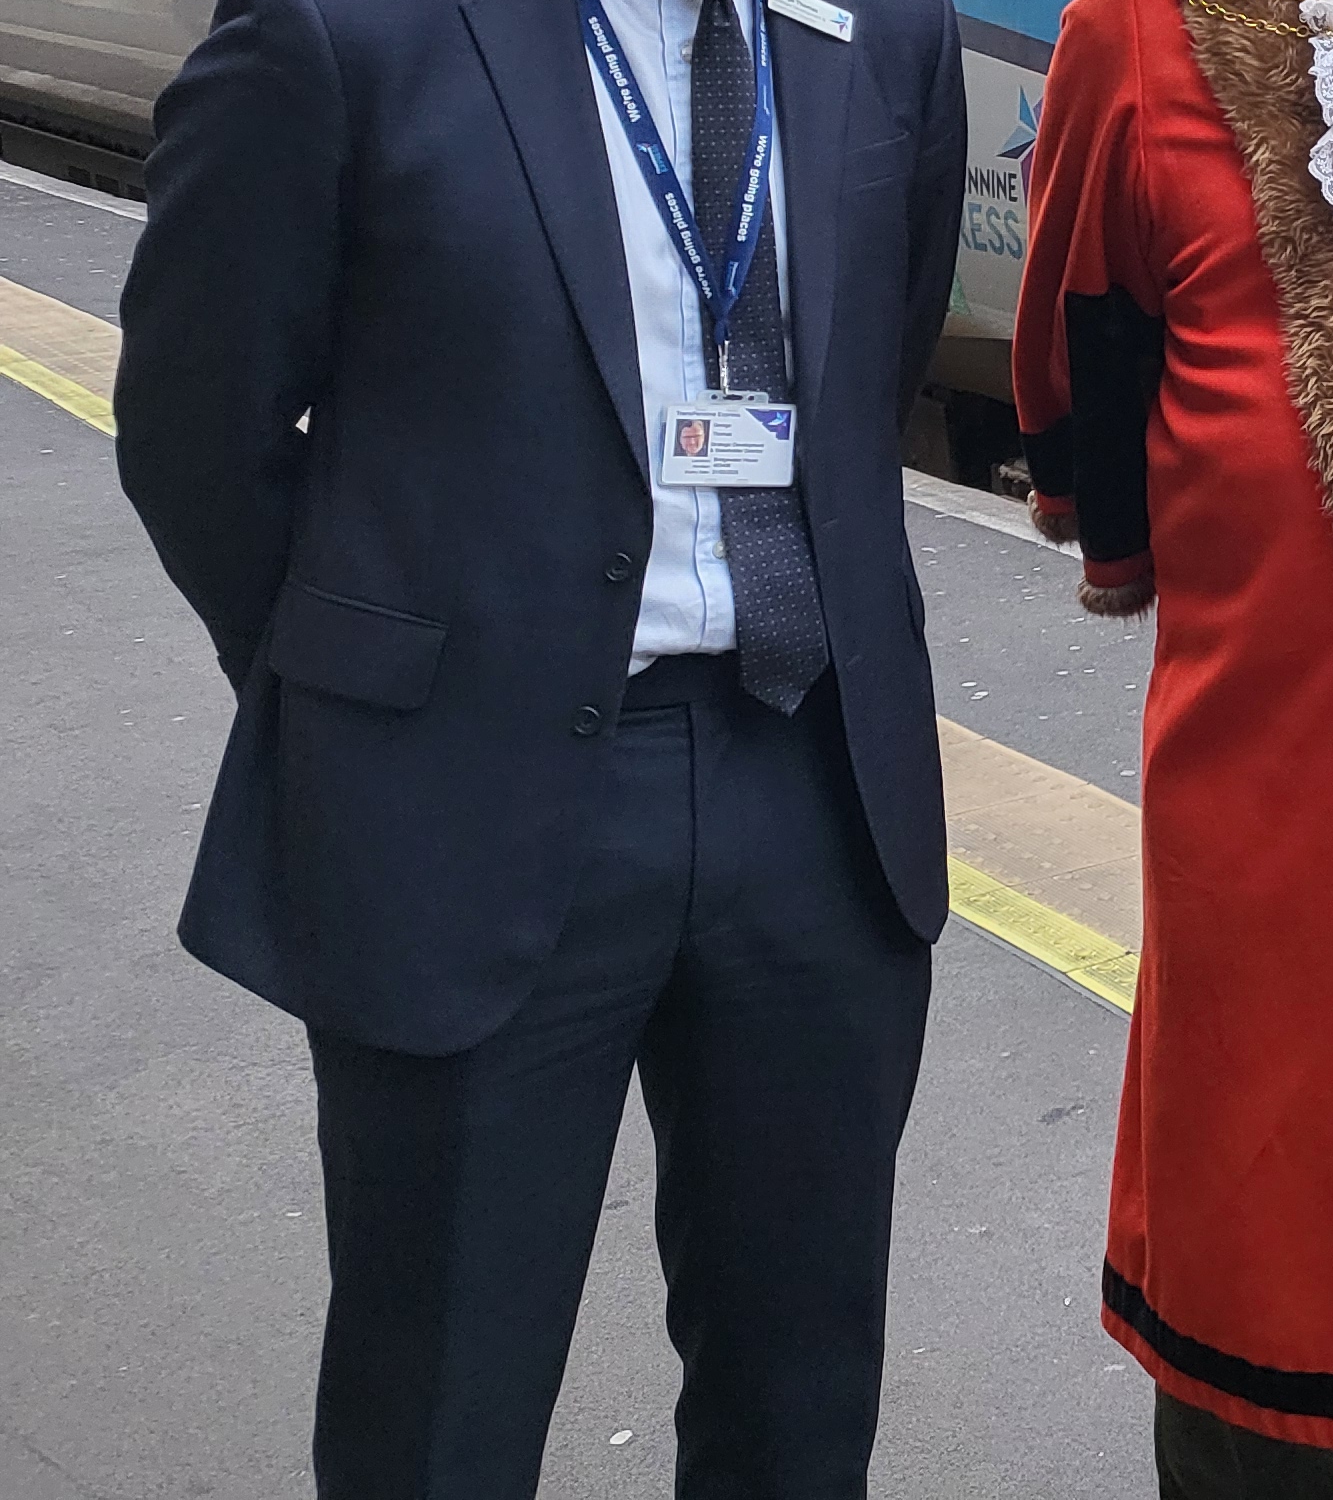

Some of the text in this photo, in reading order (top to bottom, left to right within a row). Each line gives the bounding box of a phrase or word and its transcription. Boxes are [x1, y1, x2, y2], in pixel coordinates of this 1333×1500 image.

[587, 16, 642, 123] We're going places
[754, 135, 769, 168] We're
[744, 168, 761, 202] going
[966, 166, 1018, 203] NNINE
[736, 203, 755, 243] places
[664, 192, 713, 299] We're going places
